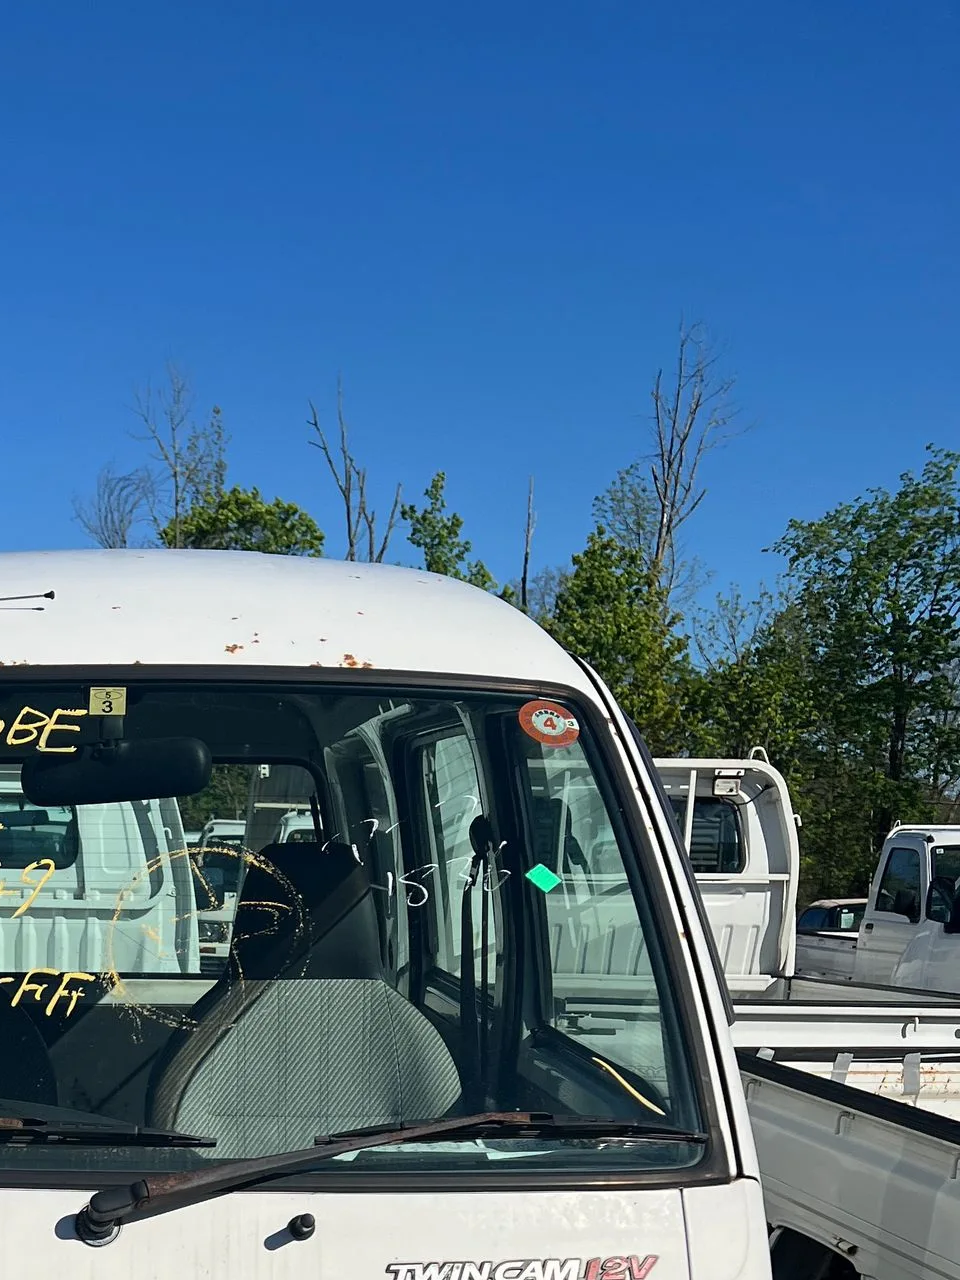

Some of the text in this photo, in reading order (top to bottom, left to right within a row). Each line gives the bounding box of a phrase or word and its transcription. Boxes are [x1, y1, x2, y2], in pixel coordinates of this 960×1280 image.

[105, 691, 112, 700] 5
[101, 700, 113, 713] 3
[543, 717, 557, 731] 4
